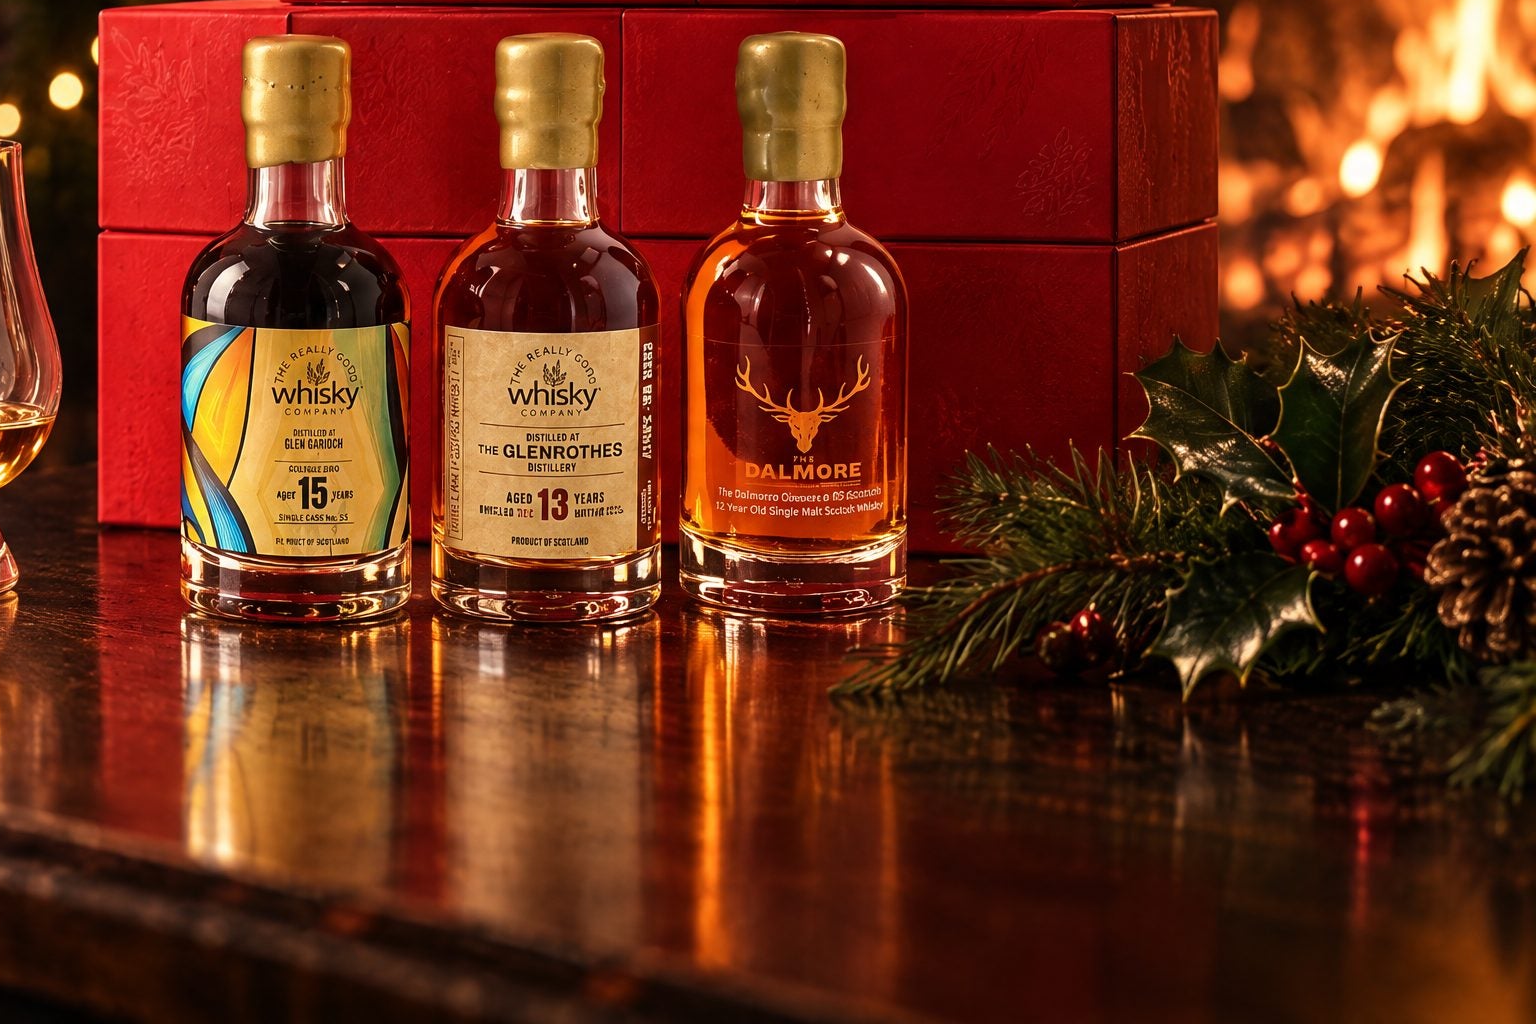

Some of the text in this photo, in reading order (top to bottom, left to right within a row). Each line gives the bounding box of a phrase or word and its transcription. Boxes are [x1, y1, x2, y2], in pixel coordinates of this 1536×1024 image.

[273, 360, 291, 384] THE
[289, 344, 335, 361] REALLY
[509, 362, 527, 385] THE
[526, 346, 573, 362] REALLY
[271, 379, 359, 410] whisky
[507, 380, 598, 411] whisky
[284, 407, 345, 416] COMPANY
[520, 408, 583, 417] COMPANY
[284, 437, 343, 449] GLEN GARIOCH
[526, 432, 580, 443] DISTILLED AT
[478, 442, 623, 460] THE GLENROTHES
[527, 462, 577, 473] DISTILLERY
[745, 462, 862, 480] DALMORE
[297, 476, 328, 510] 15
[718, 486, 733, 498] The
[506, 491, 533, 505] AGED
[537, 487, 569, 521] 13
[573, 491, 605, 505] YEARS
[715, 501, 725, 510] 12
[726, 502, 748, 514] Year
[749, 504, 767, 516] Old
[768, 506, 799, 519] Single
[543, 537, 553, 547] OF
